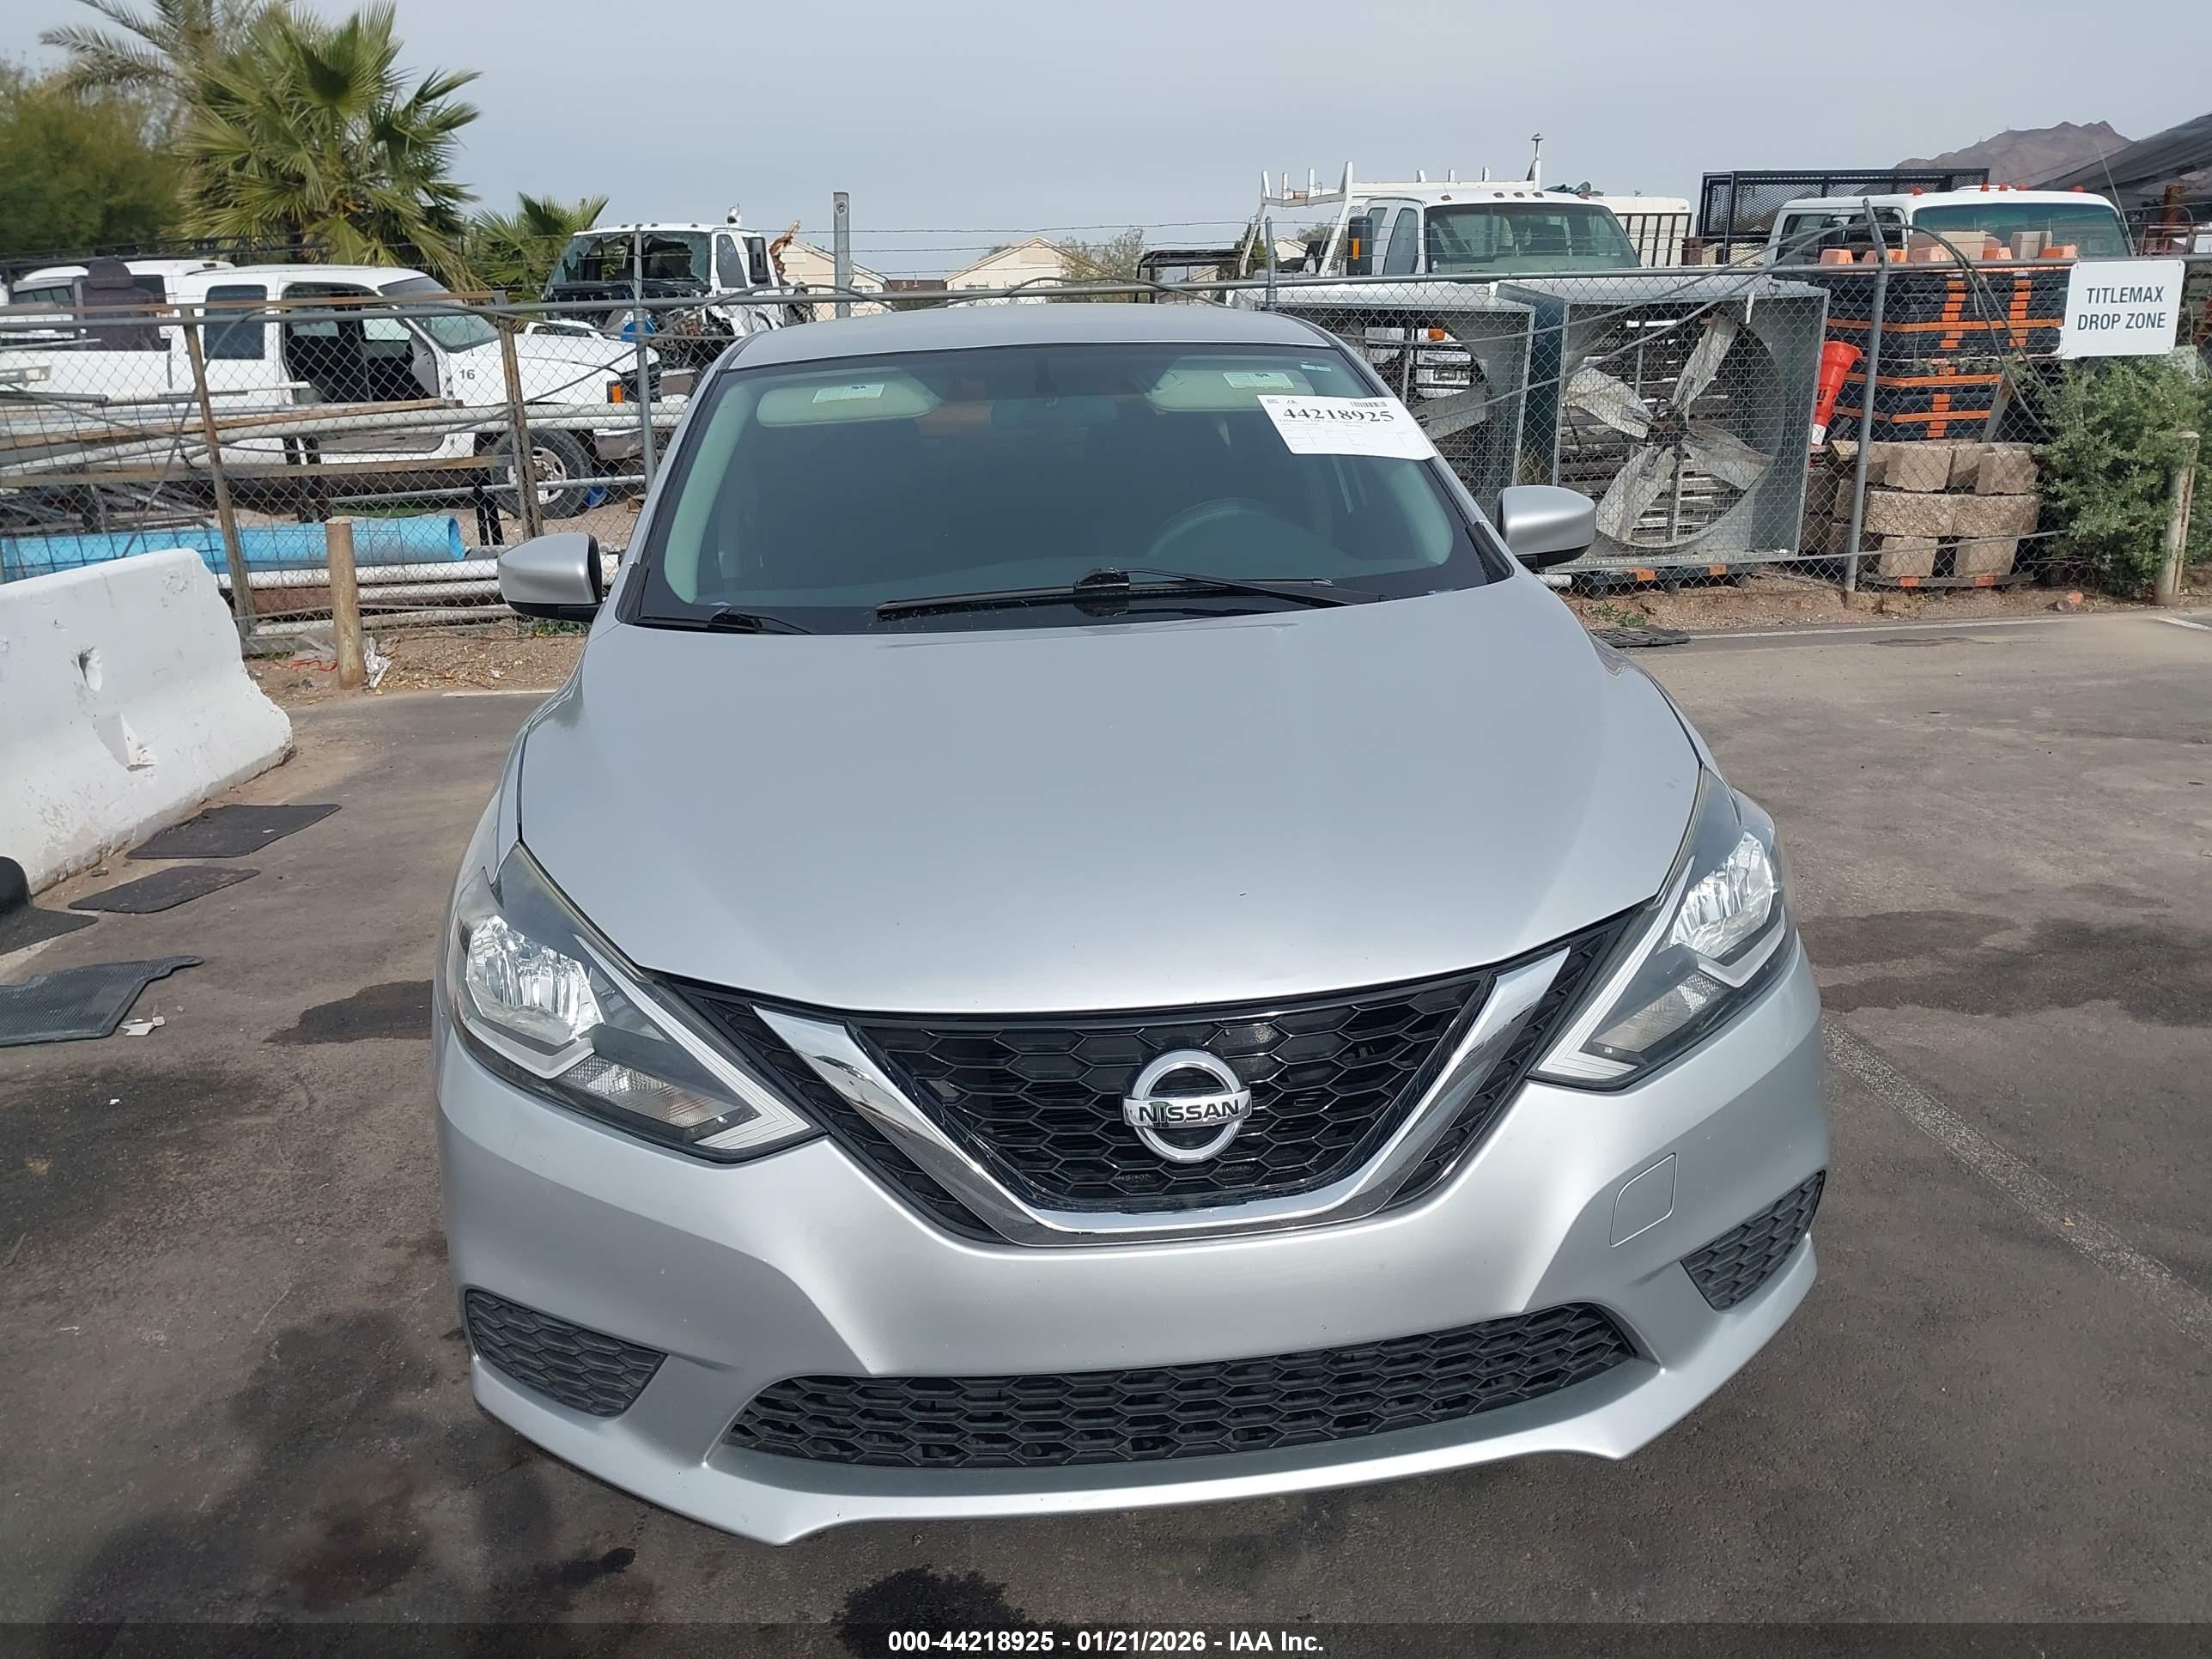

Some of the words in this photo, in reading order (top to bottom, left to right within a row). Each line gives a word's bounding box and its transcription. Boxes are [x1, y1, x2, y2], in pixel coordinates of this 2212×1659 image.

[2086, 286, 2165, 304] TITLEMAX
[2077, 313, 2121, 331] DROP
[2125, 312, 2166, 330] ZONE
[459, 368, 476, 380] 16
[1283, 408, 1395, 422] 44218925
[1139, 1099, 1240, 1121] NISSAN
